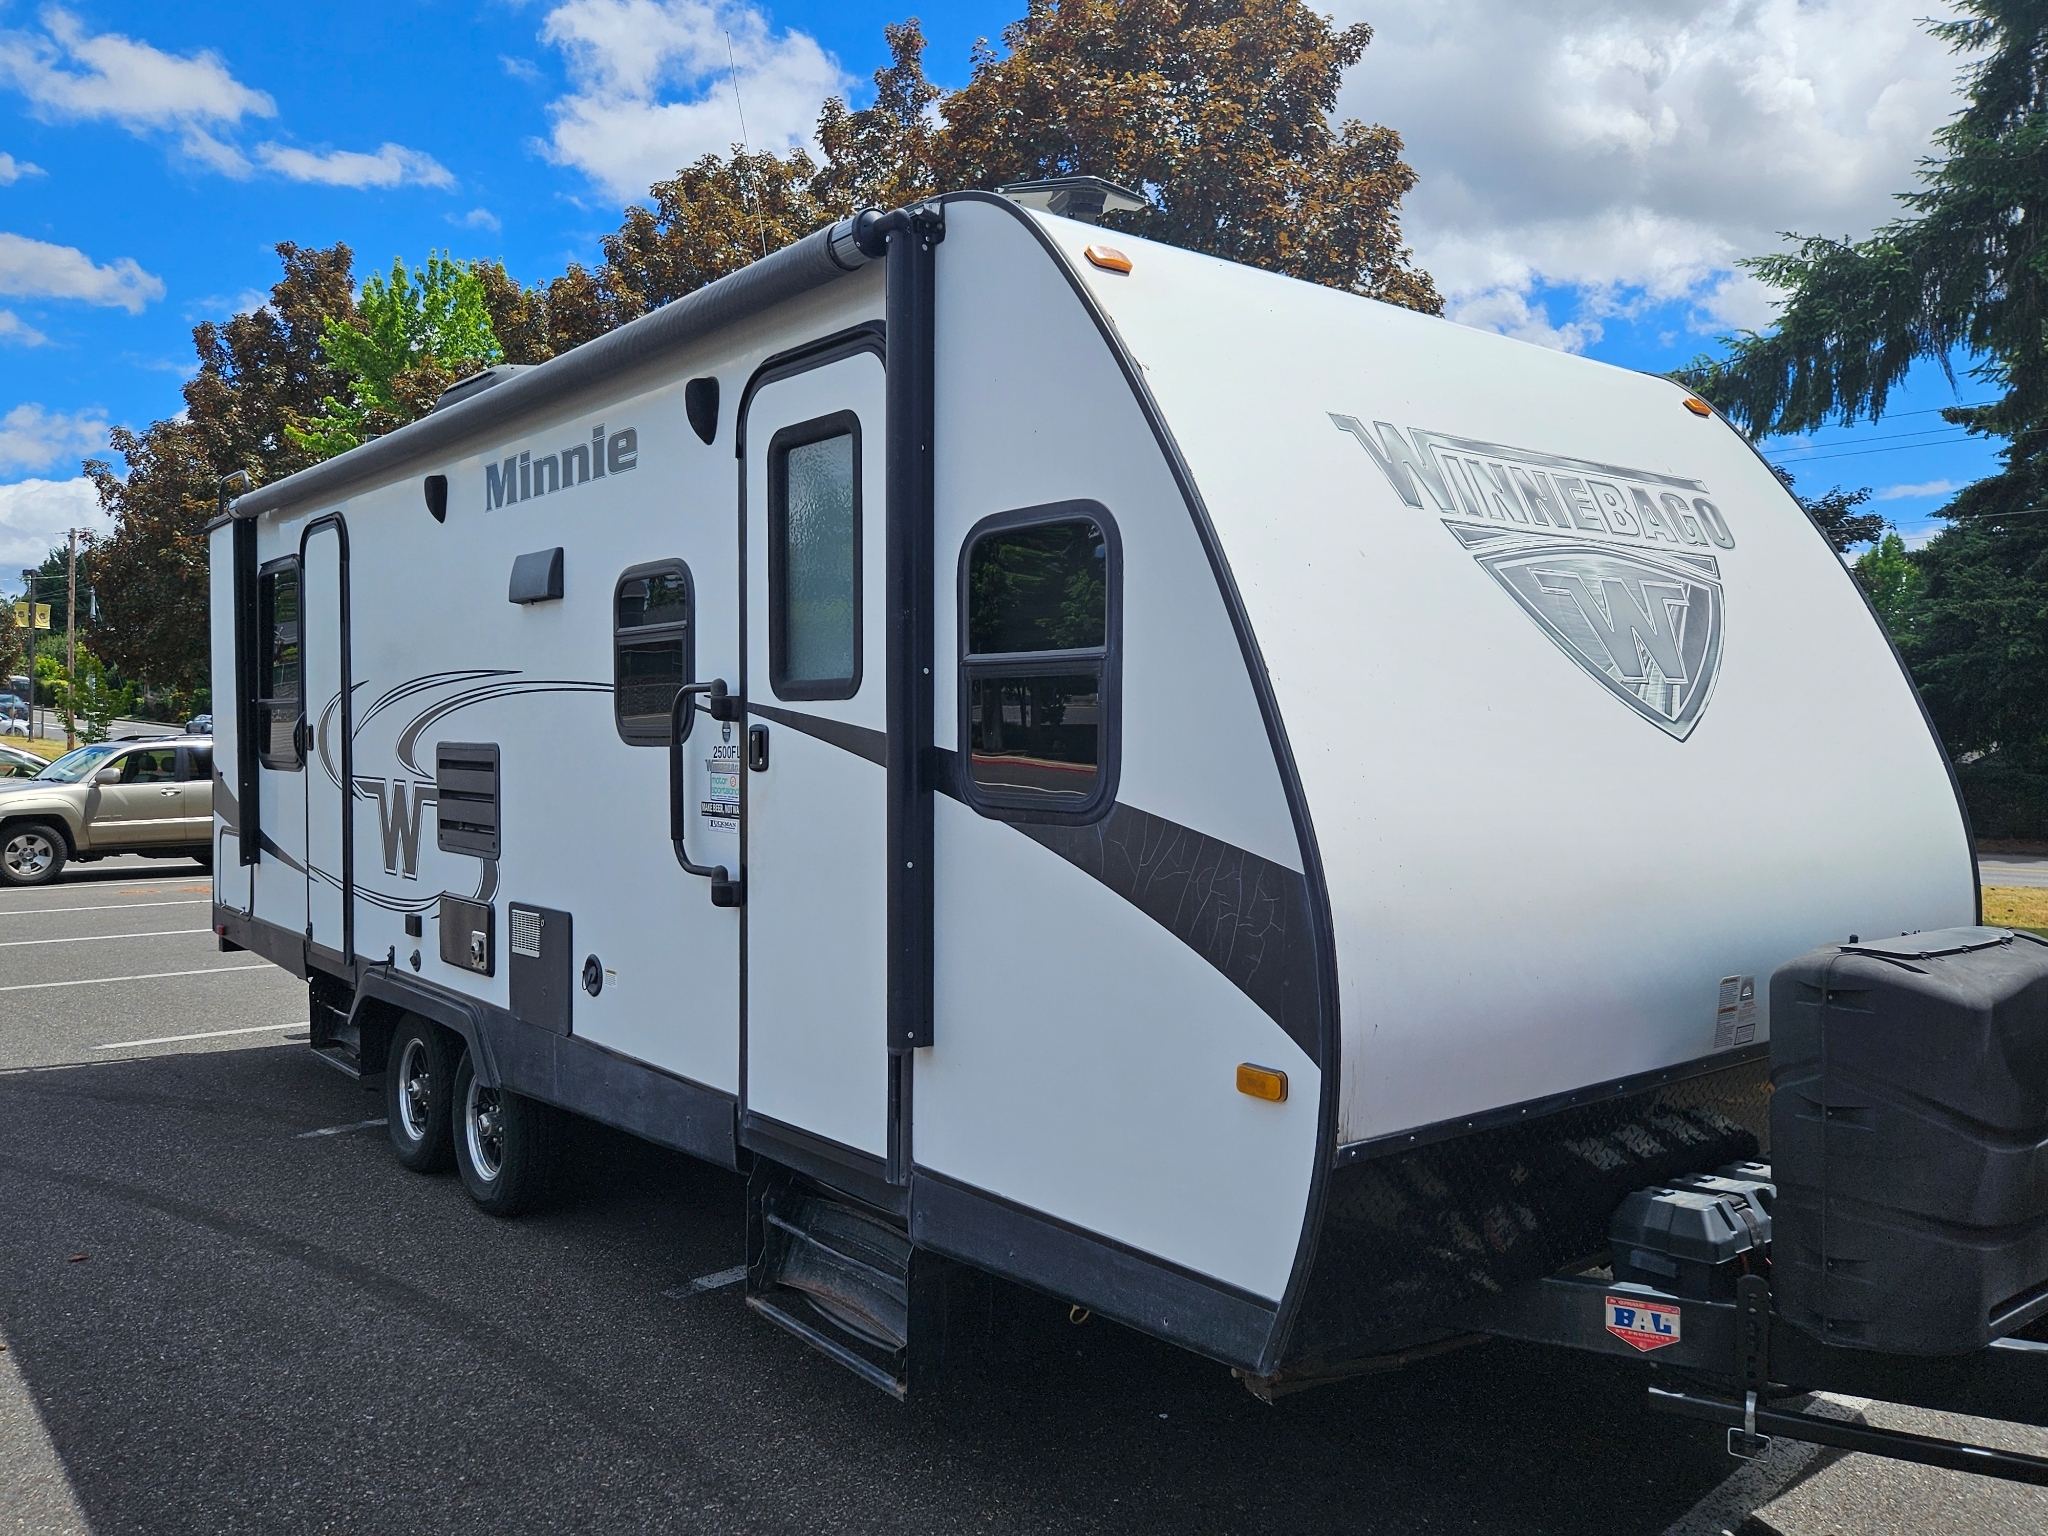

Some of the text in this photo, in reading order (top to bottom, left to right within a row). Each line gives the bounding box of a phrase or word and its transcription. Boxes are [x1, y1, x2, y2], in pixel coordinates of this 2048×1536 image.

[485, 423, 639, 513] Minnie
[1325, 411, 1737, 551] WINNEBAGO
[1527, 566, 1691, 684] W
[702, 802, 713, 812] MAKE
[1613, 1306, 1672, 1335] BAL
[1628, 1331, 1670, 1341] PRODUCTS
